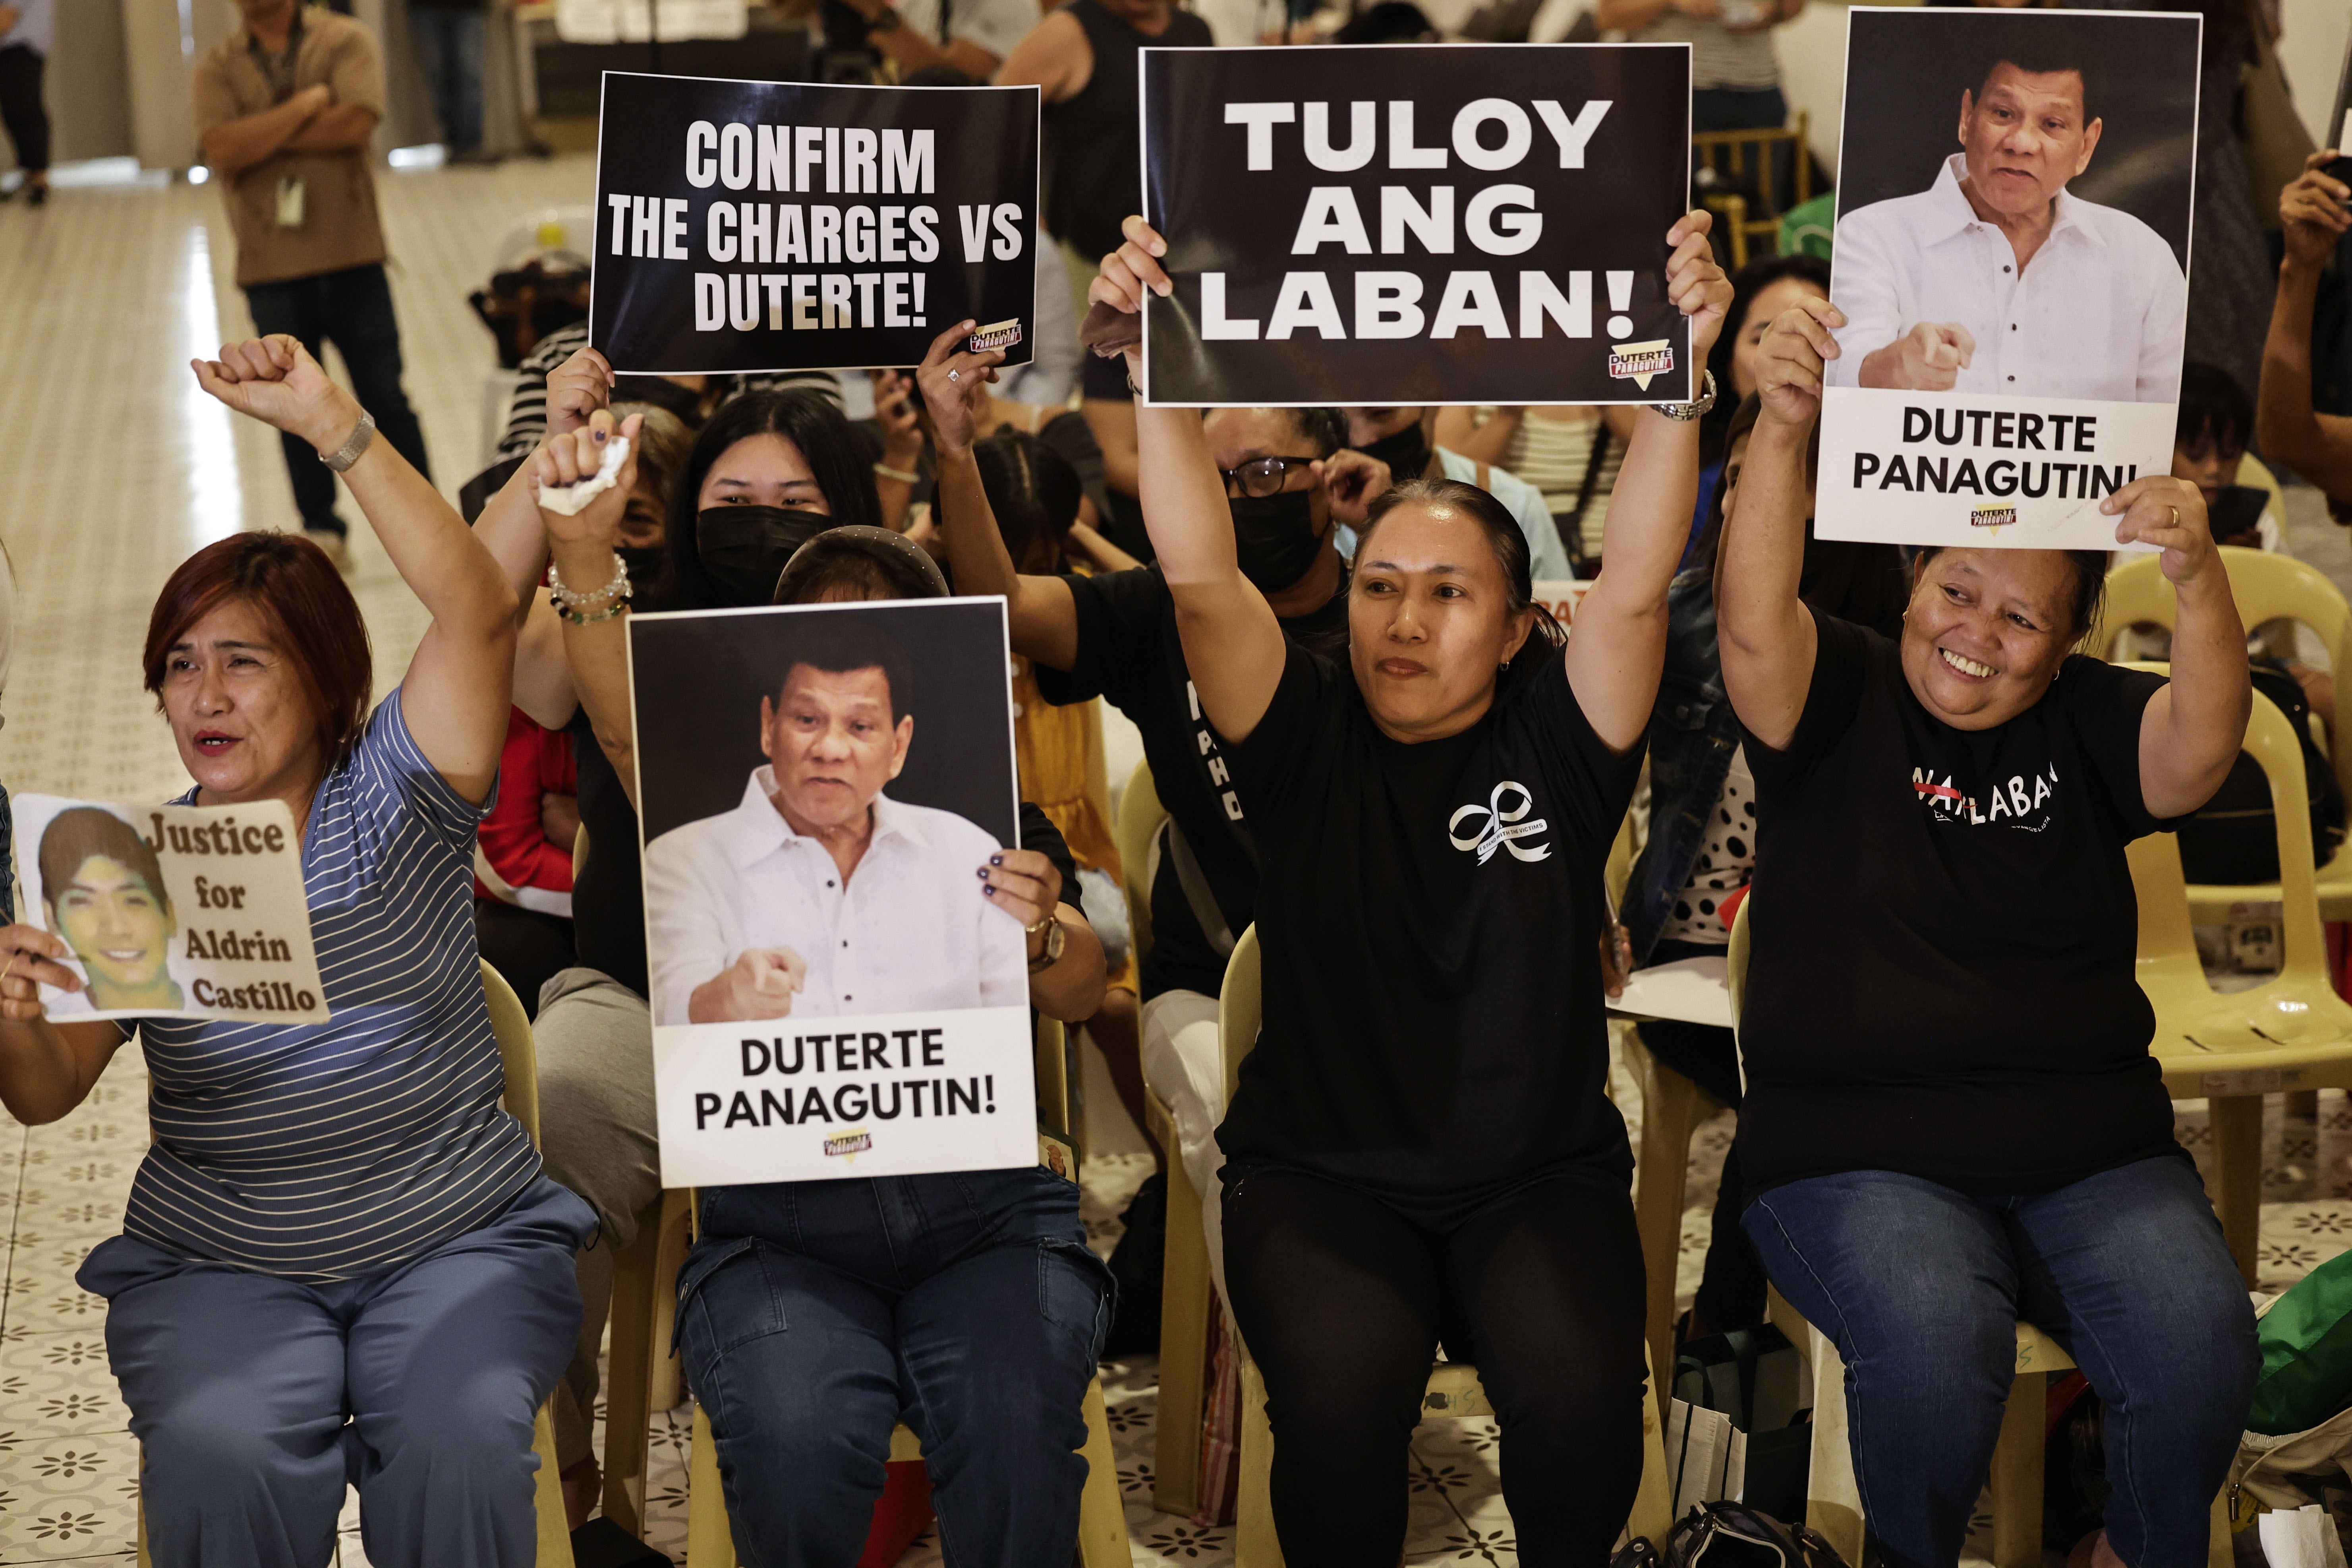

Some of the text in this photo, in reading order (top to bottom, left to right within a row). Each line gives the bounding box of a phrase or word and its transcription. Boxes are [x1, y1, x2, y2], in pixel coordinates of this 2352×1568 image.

[1225, 98, 1613, 172] TULOY
[686, 121, 934, 193] CONFIRM
[609, 194, 1022, 263] THE CHARGES VS
[1291, 184, 1542, 255] ANG
[695, 273, 926, 331] DUTERTE!
[1201, 271, 1634, 340] LABAN!
[972, 325, 1020, 341] DUTERTE
[976, 333, 1017, 349] PANAGUTIN!
[1611, 350, 1672, 364] DUTERTE
[1615, 359, 1668, 374] PANAGUTIN!
[1903, 407, 2096, 452] DUTERTE
[1971, 508, 2016, 517] DUTERTE
[146, 813, 284, 855] Justice
[1483, 838, 1496, 849] STAND
[1496, 831, 1509, 839] WITH
[1519, 823, 1543, 833] VICTIMS
[195, 876, 245, 909] for
[186, 928, 292, 961] Aldrin
[193, 979, 316, 1011] Castillo
[742, 1029, 944, 1076] DUTERTE
[695, 1075, 996, 1130] PANAGUTIN!
